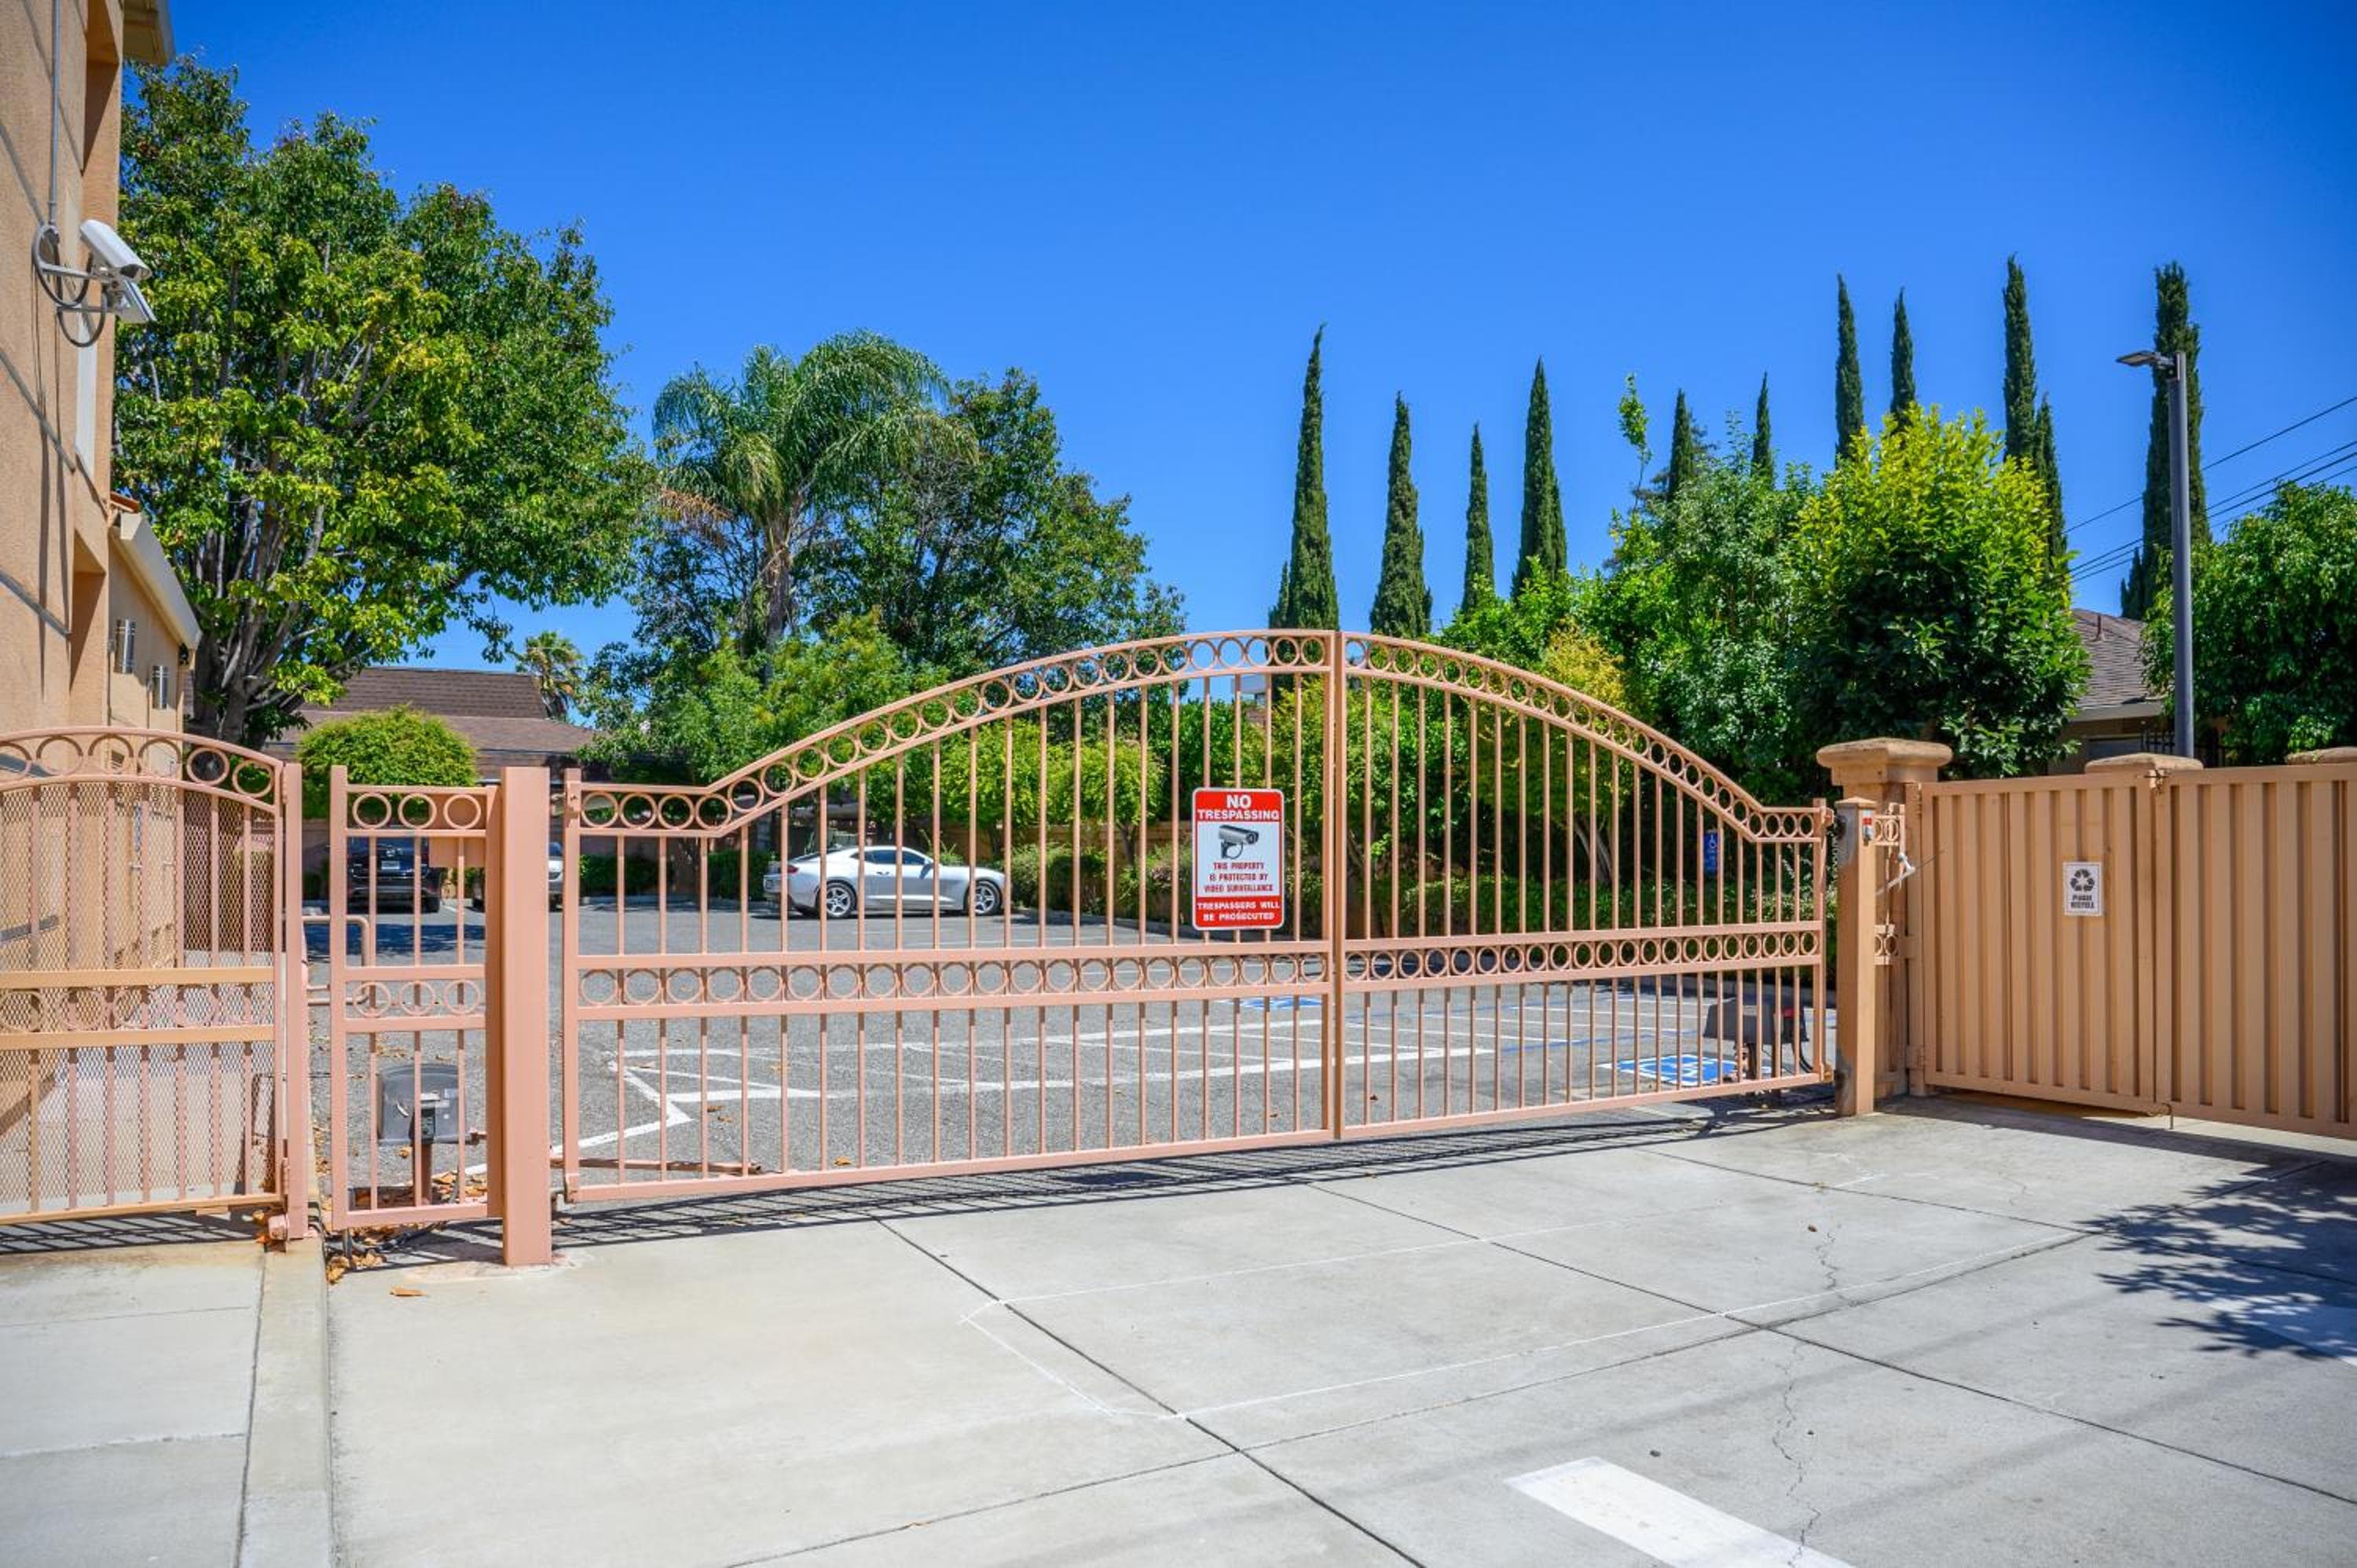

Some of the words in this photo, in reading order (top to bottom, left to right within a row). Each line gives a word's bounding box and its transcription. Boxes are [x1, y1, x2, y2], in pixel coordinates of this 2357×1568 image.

[1226, 794, 1252, 808] NO
[1197, 809, 1280, 819] TRESPASSING
[1197, 902, 1256, 910] TRESPASSERS
[1219, 912, 1274, 921] PROSECUTED
